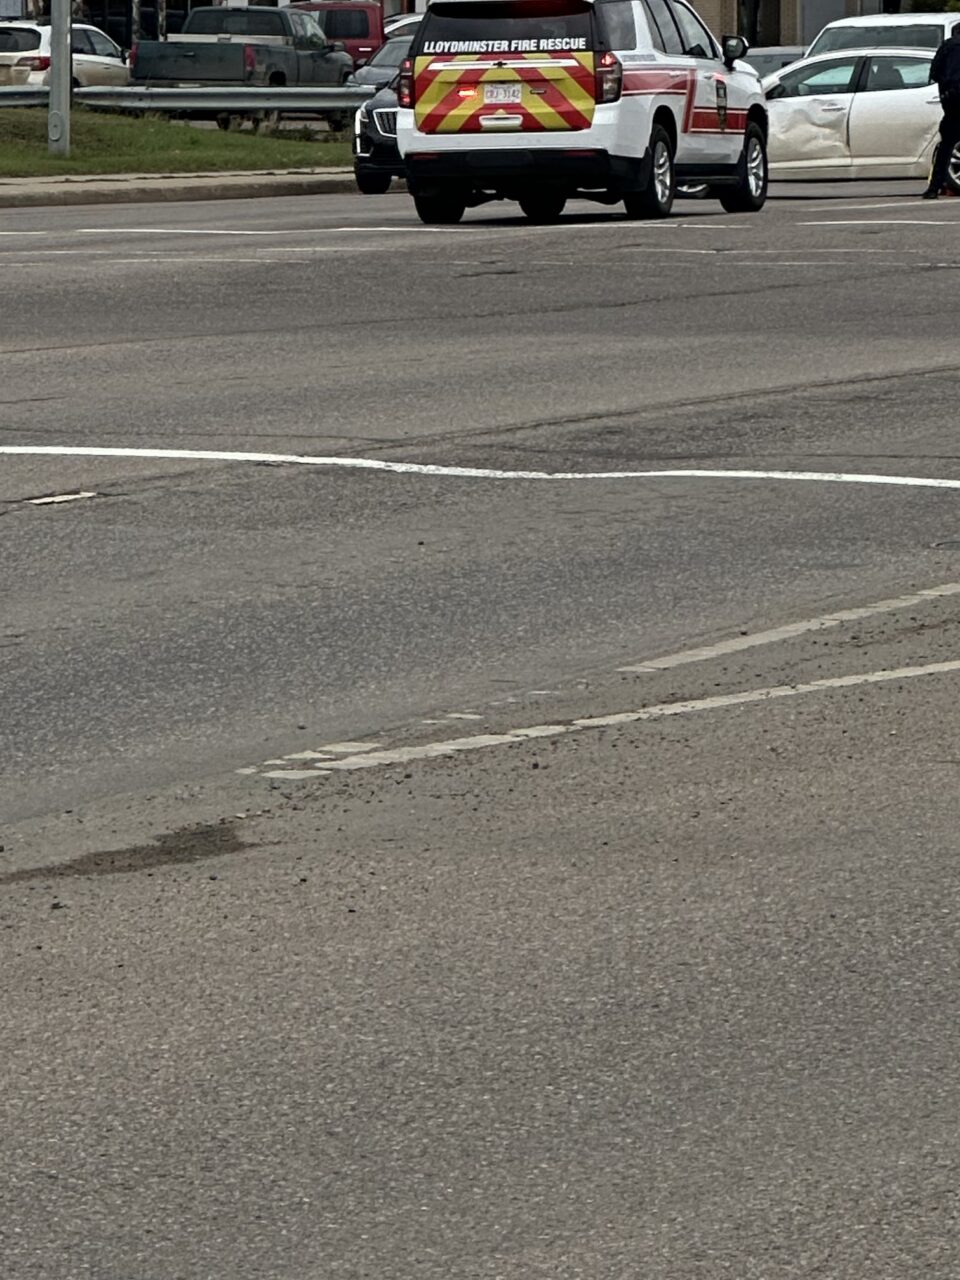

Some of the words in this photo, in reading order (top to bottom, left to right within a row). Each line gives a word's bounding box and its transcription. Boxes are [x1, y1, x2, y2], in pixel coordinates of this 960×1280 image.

[423, 40, 509, 53] LLOYDMINSTER
[510, 39, 538, 51] FIRE
[539, 37, 587, 50] RESCUE
